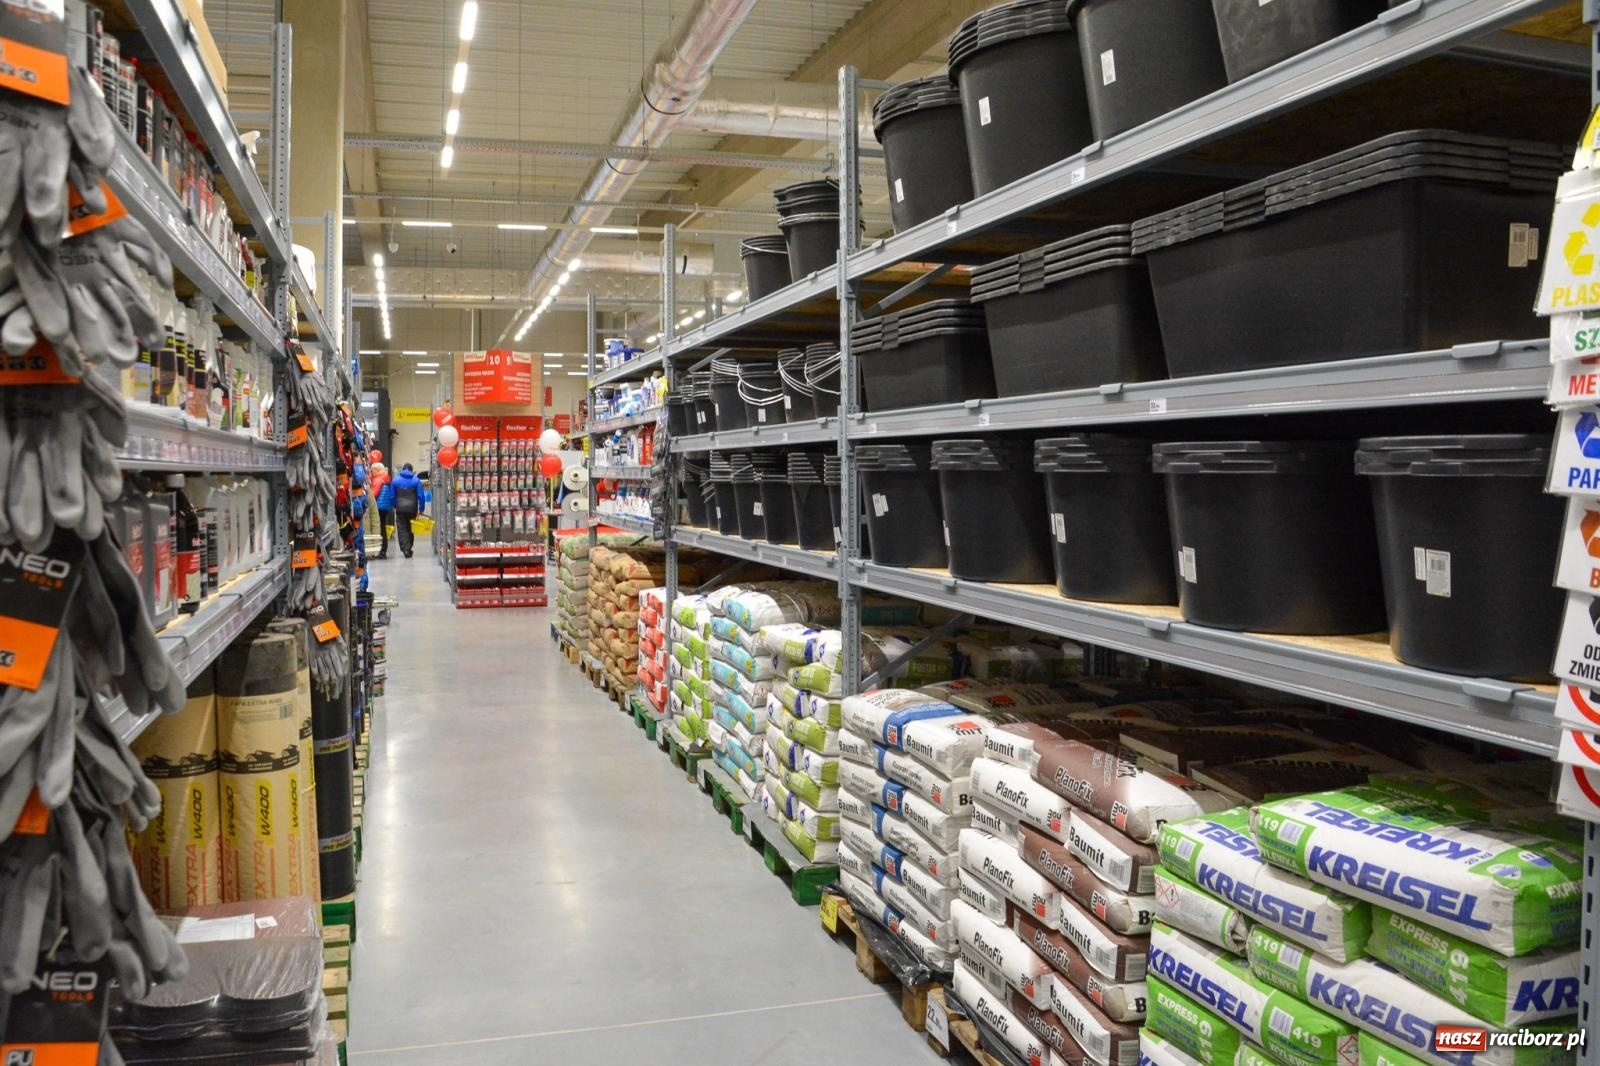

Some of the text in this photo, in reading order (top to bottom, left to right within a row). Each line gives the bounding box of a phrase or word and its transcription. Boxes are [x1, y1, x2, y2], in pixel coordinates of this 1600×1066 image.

[1575, 328, 1600, 352] SZ
[490, 355, 500, 366] 10
[1568, 373, 1600, 396] ME
[0, 547, 71, 579] NEO
[838, 740, 859, 755] Baumit
[906, 734, 933, 759] Baumit
[984, 735, 1014, 759] Baumit
[995, 780, 1030, 809] PlanoFix
[1055, 767, 1094, 801] PlanoFix
[192, 788, 203, 839] W400
[226, 786, 236, 837] W400
[259, 786, 271, 837] W400
[838, 798, 859, 815] Baumit
[904, 803, 930, 830] Baumit
[972, 806, 1002, 832] Baumit
[1069, 826, 1105, 868] Baumit
[1303, 801, 1485, 861] KREISEL
[838, 852, 859, 871] Baumit
[983, 857, 1015, 889] PlanoFix
[1039, 849, 1074, 888] PlanoFix
[903, 869, 927, 899] Baumit
[1308, 845, 1492, 931] KREISEL
[1198, 863, 1328, 940] KREISEL
[901, 931, 925, 958] Baumit
[1059, 910, 1092, 954] Baumit
[1253, 934, 1278, 954] 419
[1389, 914, 1449, 954] EXPRESS
[973, 931, 1004, 966] PlanoFix
[1034, 929, 1070, 974] PlanoFix
[32, 971, 98, 991] NEO
[1147, 944, 1254, 1033] KREISEL
[976, 997, 1009, 1036] PlanoFix
[1050, 985, 1086, 1039] Baumit
[1157, 992, 1199, 1025] EXPRESS
[1027, 1008, 1065, 1051] PlanoFix
[1292, 1026, 1322, 1048] 419
